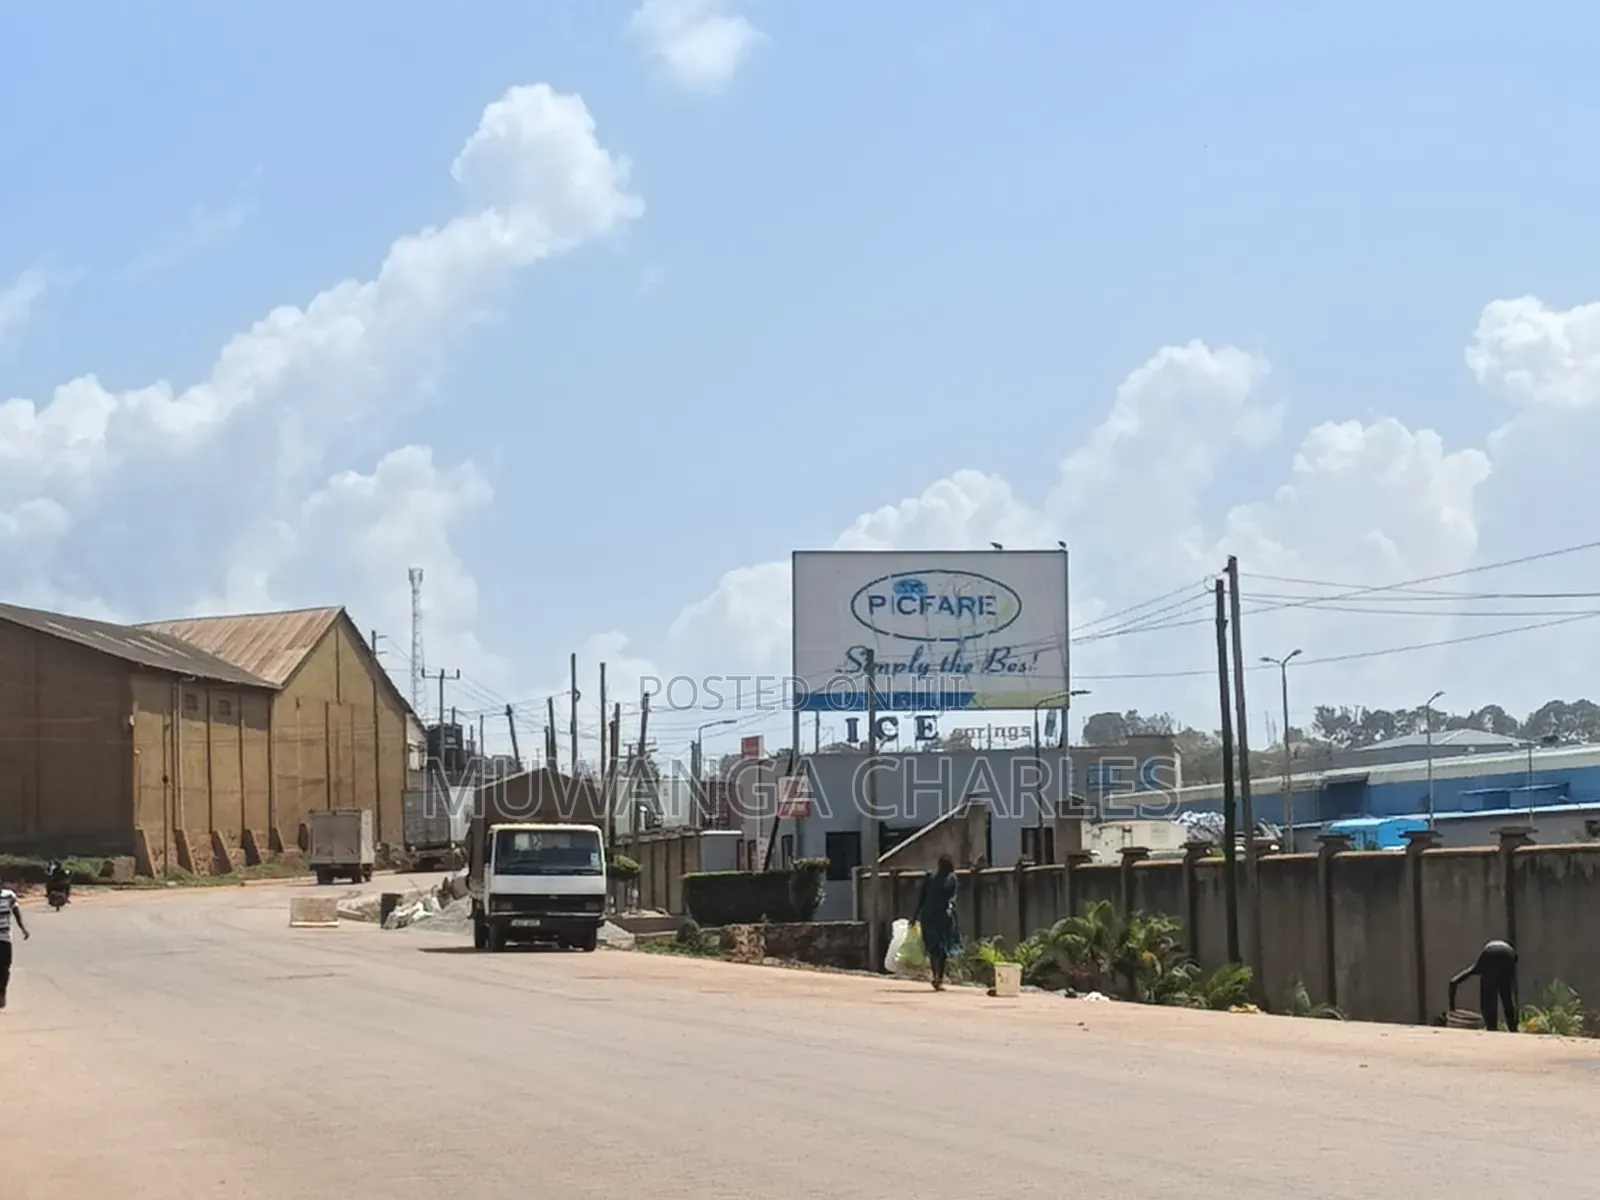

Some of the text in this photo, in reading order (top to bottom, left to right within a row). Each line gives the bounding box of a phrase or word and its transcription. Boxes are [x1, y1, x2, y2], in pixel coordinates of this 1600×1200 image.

[868, 595, 997, 617] PICFARE
[939, 646, 973, 674] the
[979, 646, 1039, 674] Bes!
[845, 715, 939, 743] ICE
